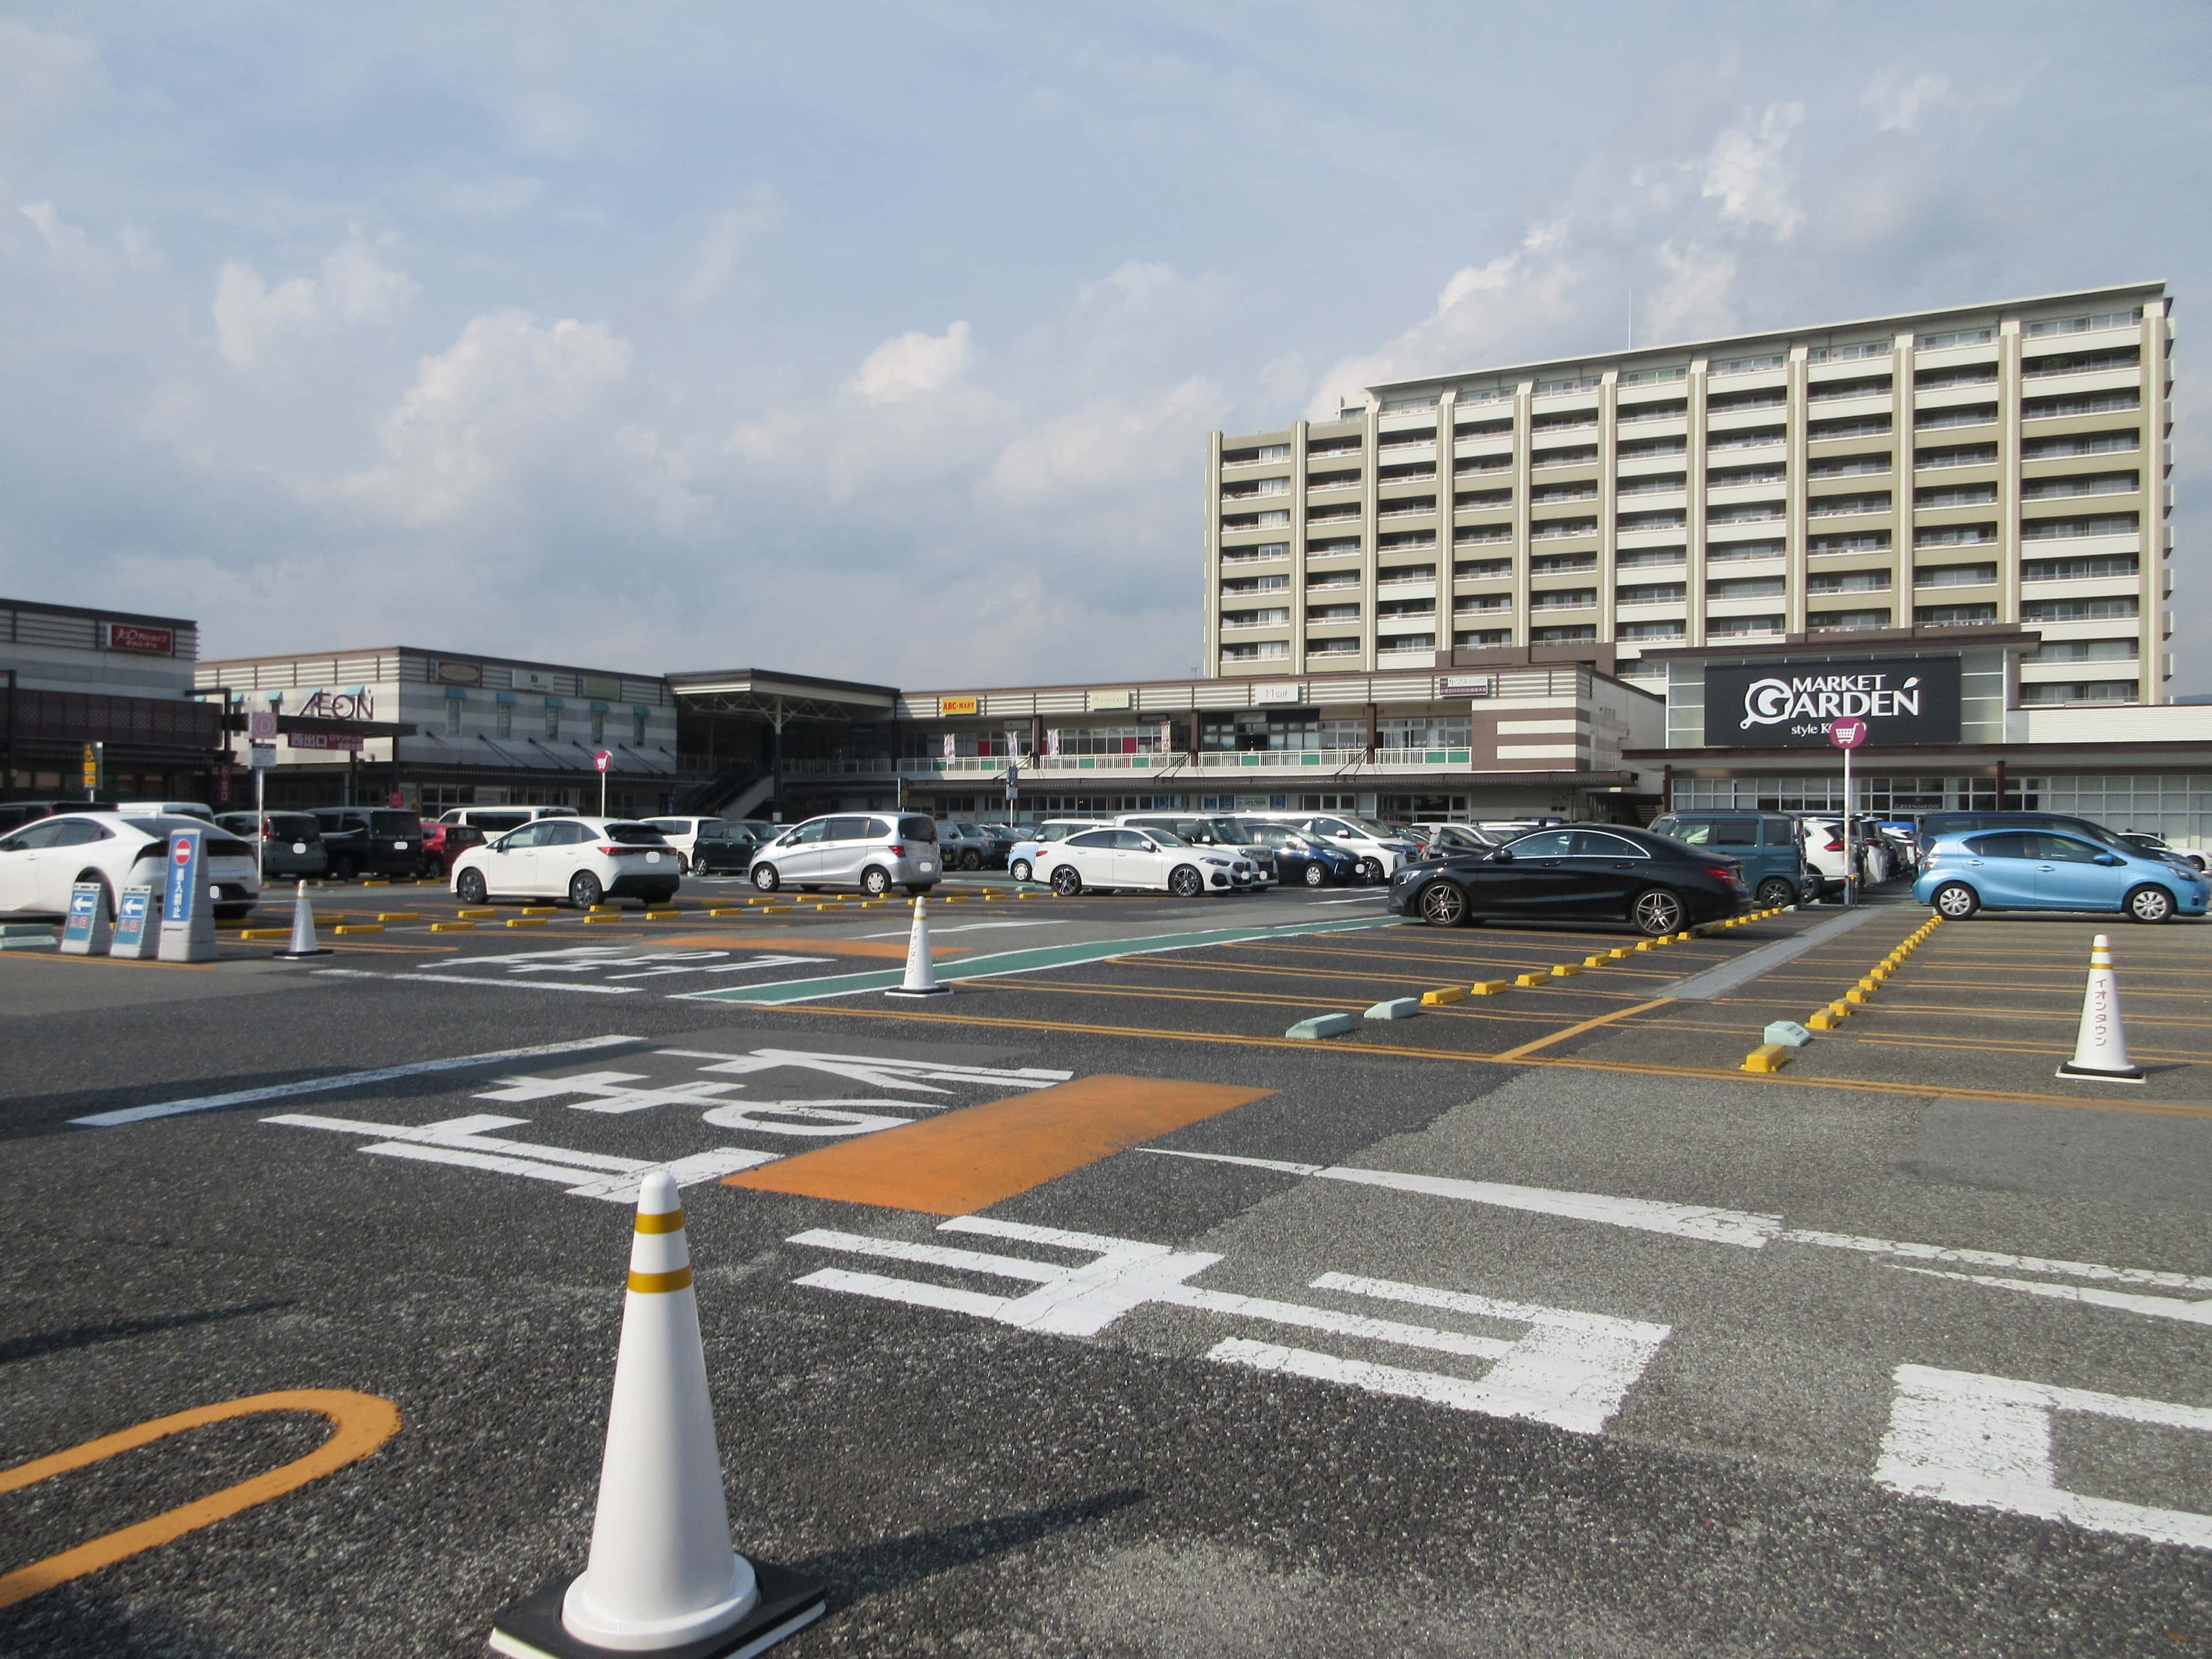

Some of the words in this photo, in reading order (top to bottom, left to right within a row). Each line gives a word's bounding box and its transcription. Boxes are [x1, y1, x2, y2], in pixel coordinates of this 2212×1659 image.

[1744, 679, 1919, 723] GARDEN
[1792, 673, 1887, 692] MARKET
[1791, 724, 1818, 737] style
[908, 927, 919, 974] イオンタウン
[2094, 979, 2107, 1047] イオンタウン
